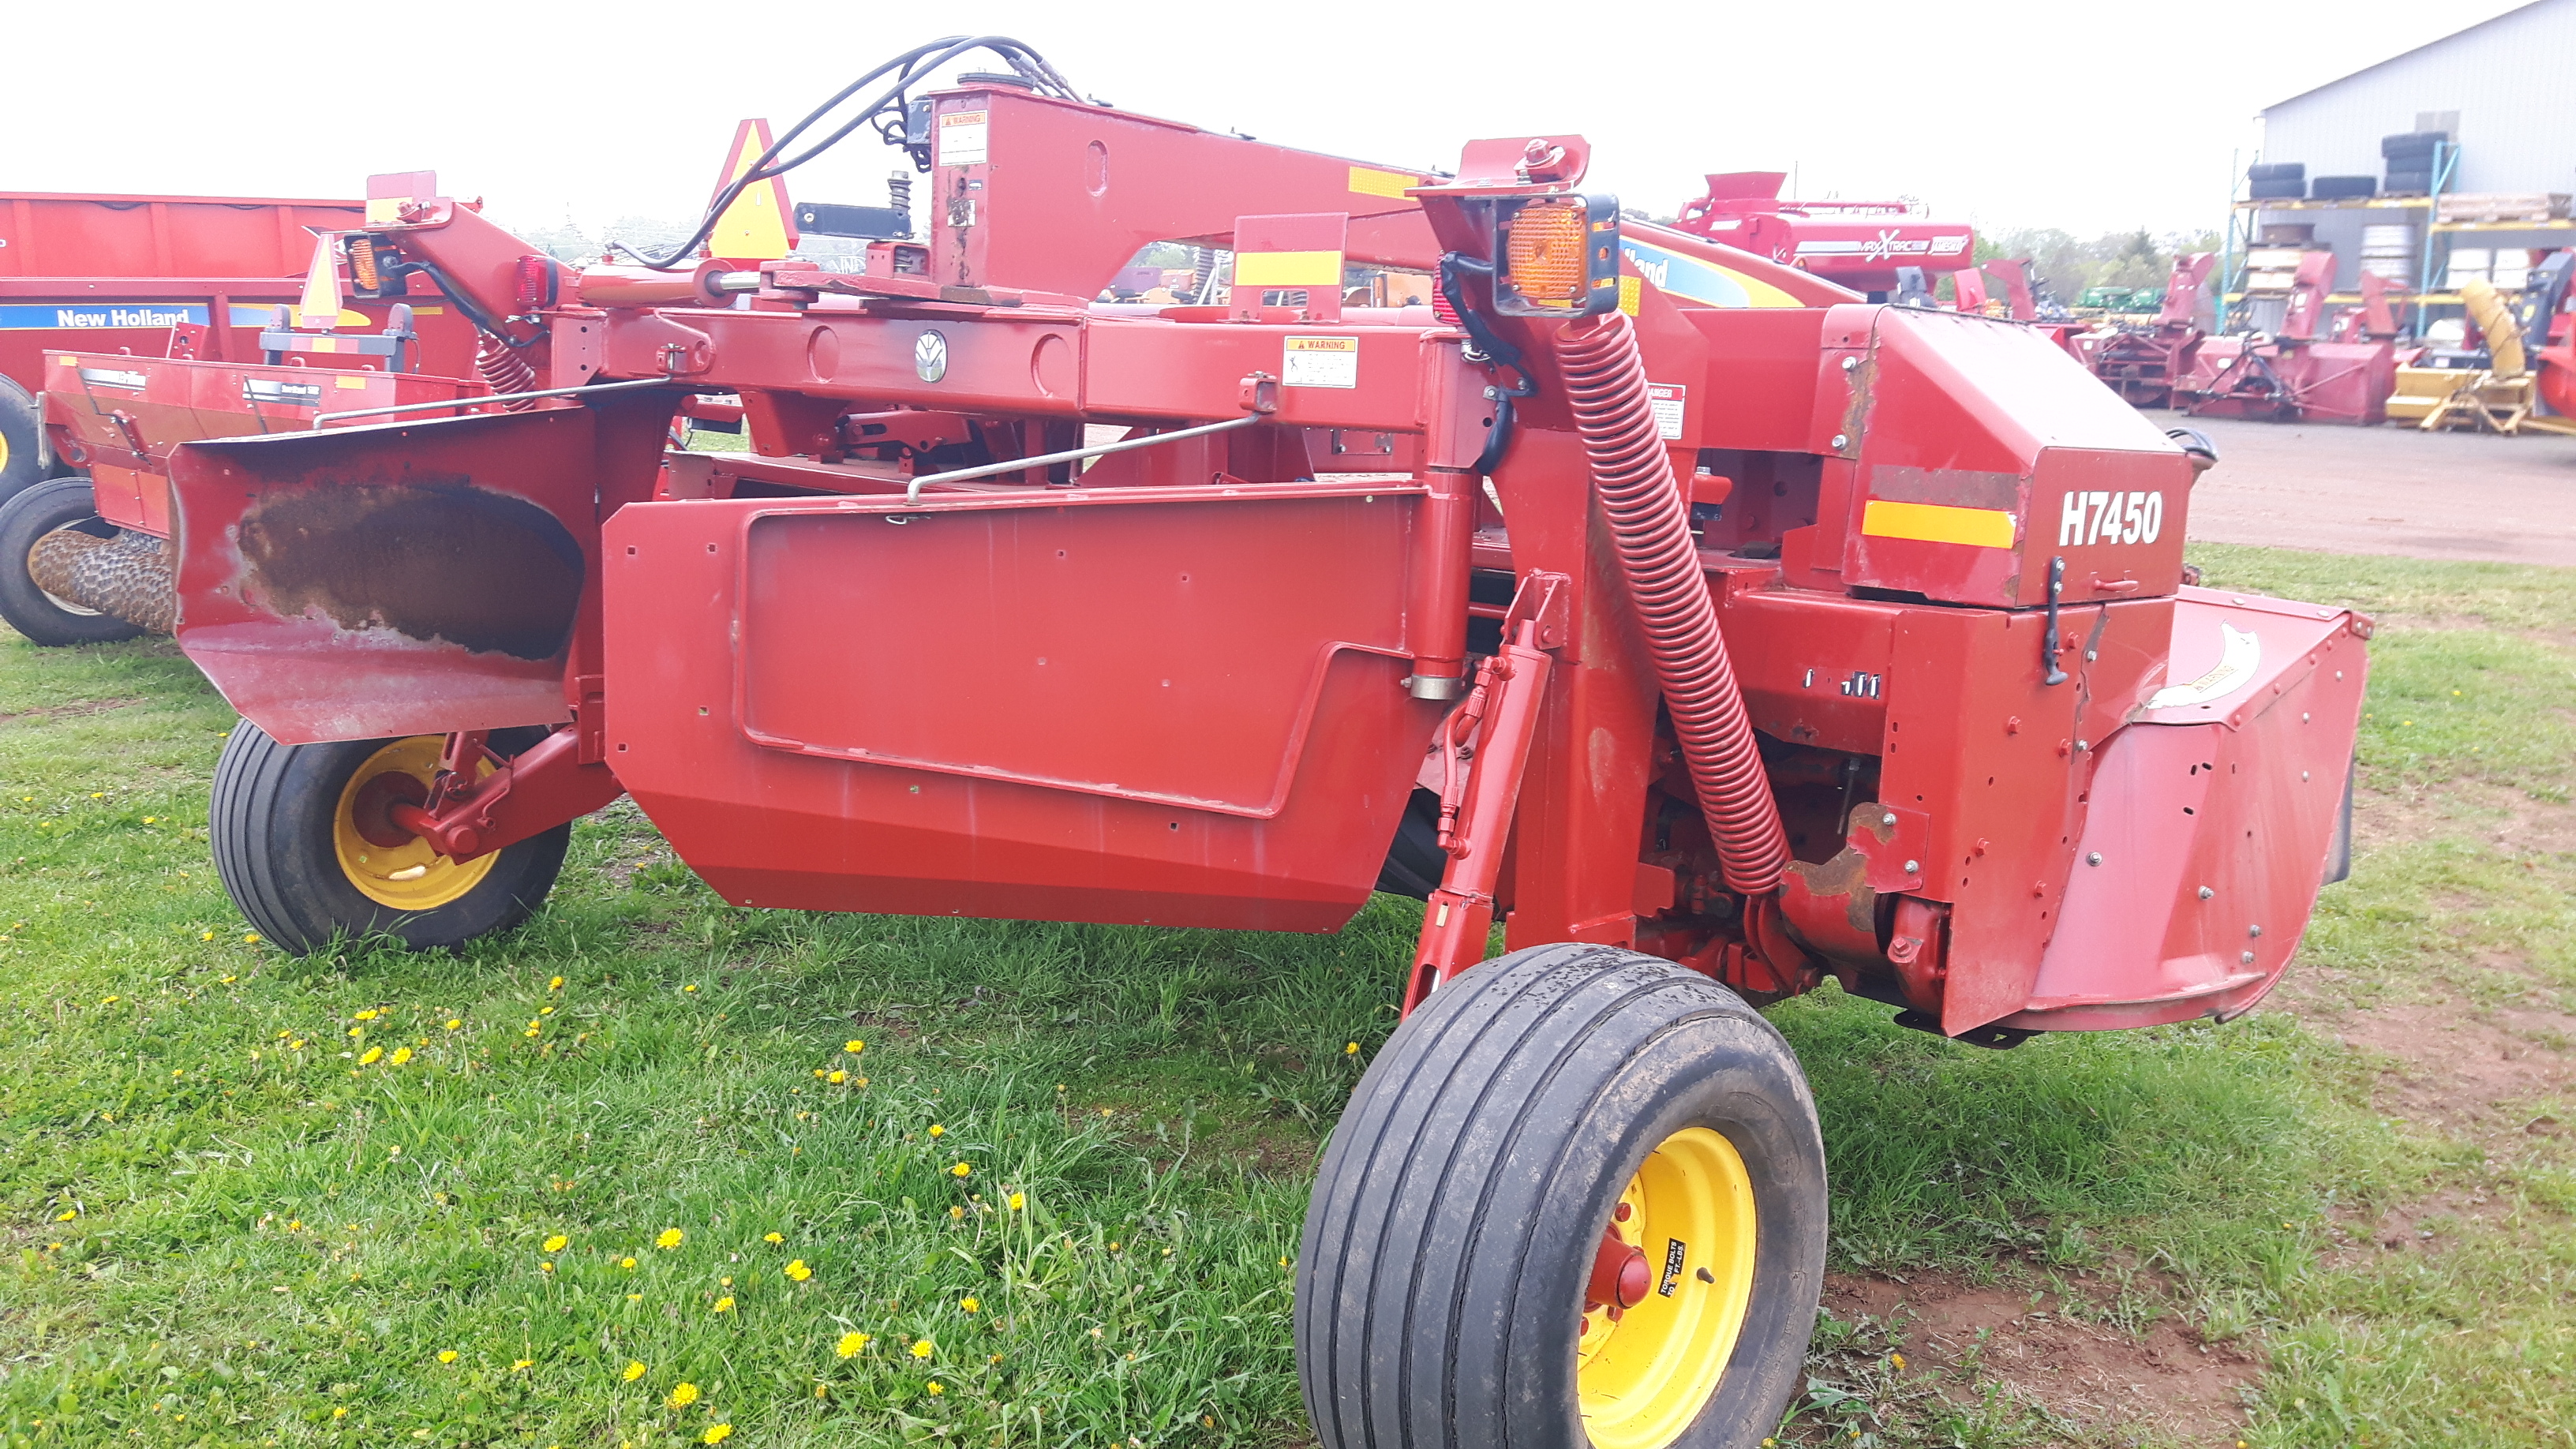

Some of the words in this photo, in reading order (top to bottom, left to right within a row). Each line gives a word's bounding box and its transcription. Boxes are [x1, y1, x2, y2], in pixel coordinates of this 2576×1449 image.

[57, 309, 107, 327] New
[110, 309, 189, 326] Holland
[1308, 340, 1346, 350] WARNING
[2058, 490, 2163, 547] H7450
[1661, 1264, 1674, 1294] TORQUE
[1668, 1241, 1677, 1264] BOLTS
